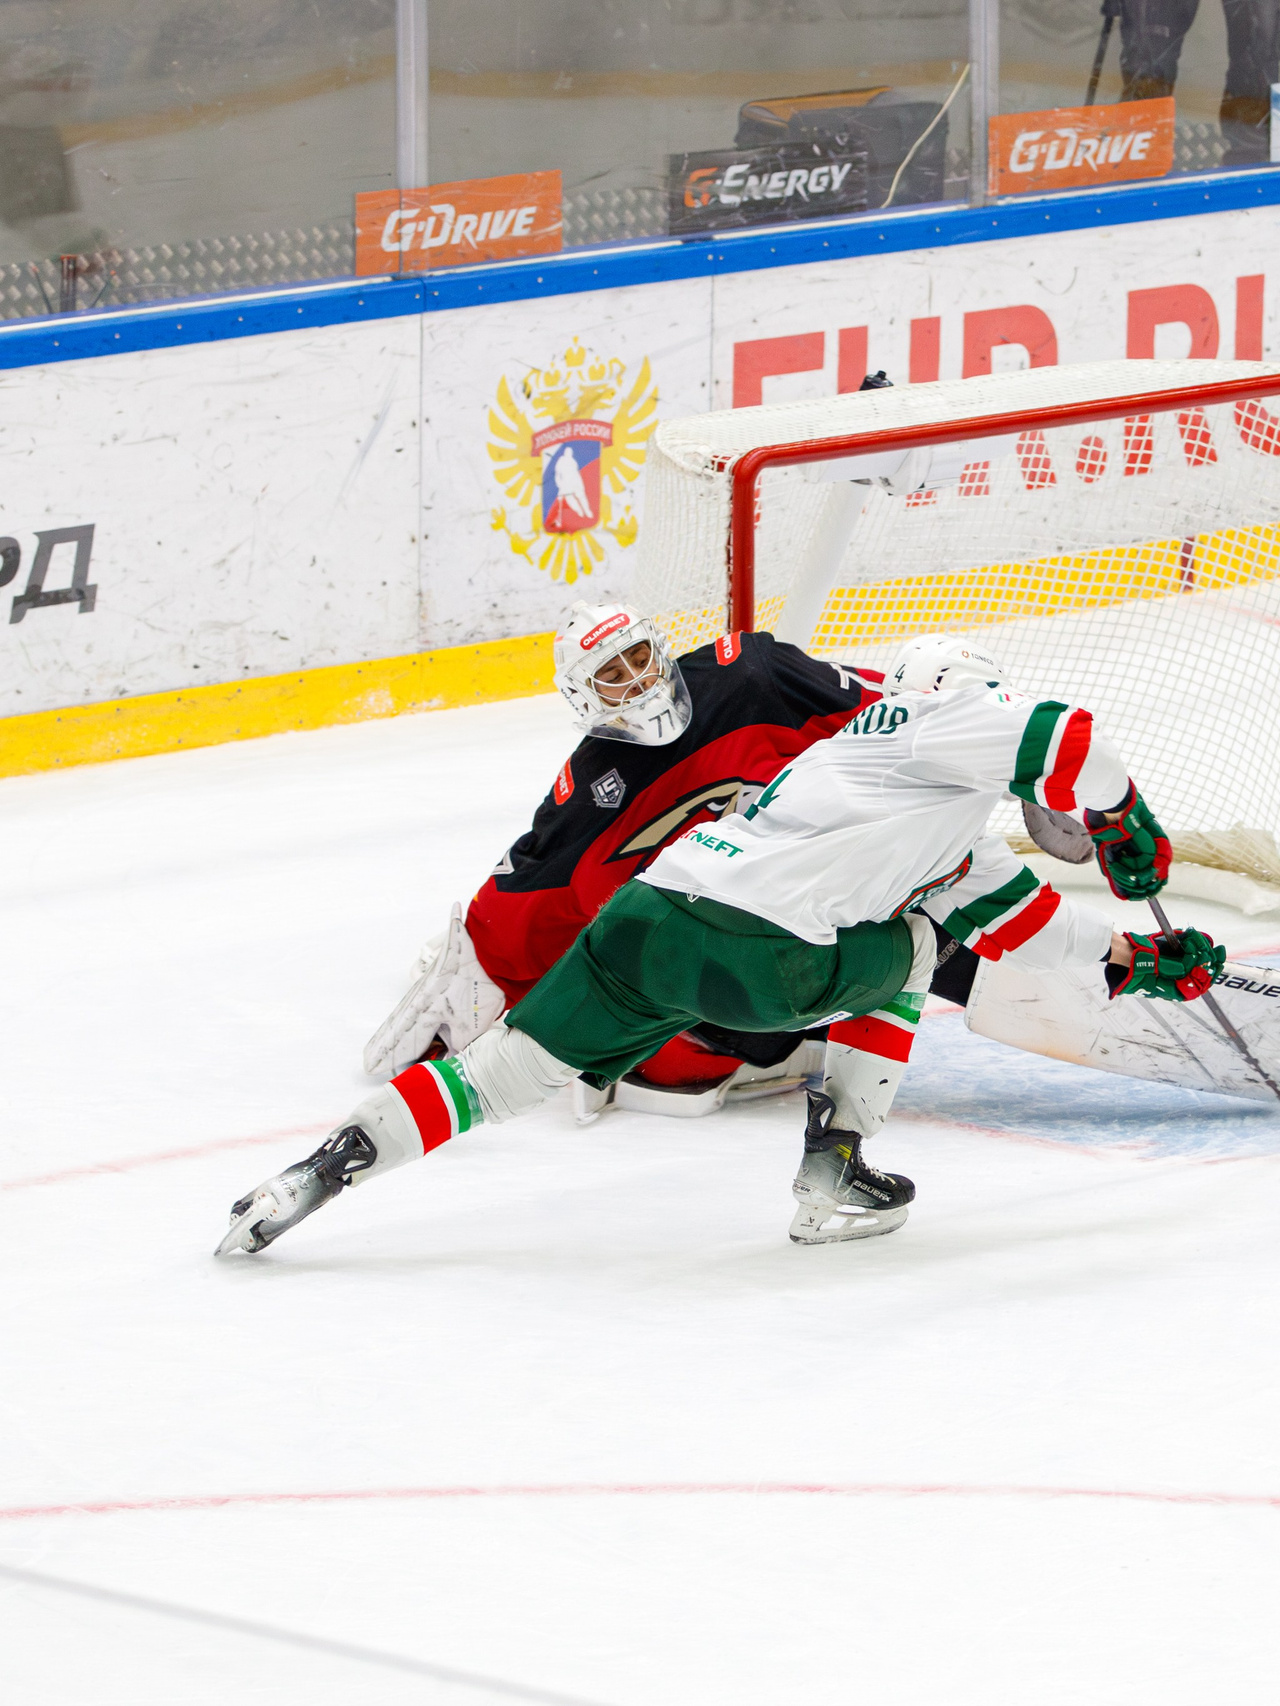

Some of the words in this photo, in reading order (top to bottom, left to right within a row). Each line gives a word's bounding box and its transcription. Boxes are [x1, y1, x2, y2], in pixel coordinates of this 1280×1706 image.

[582, 614, 627, 647] OLIMPBET
[894, 663, 906, 683] 4
[649, 709, 676, 738] 77
[680, 830, 744, 858] TNEFT
